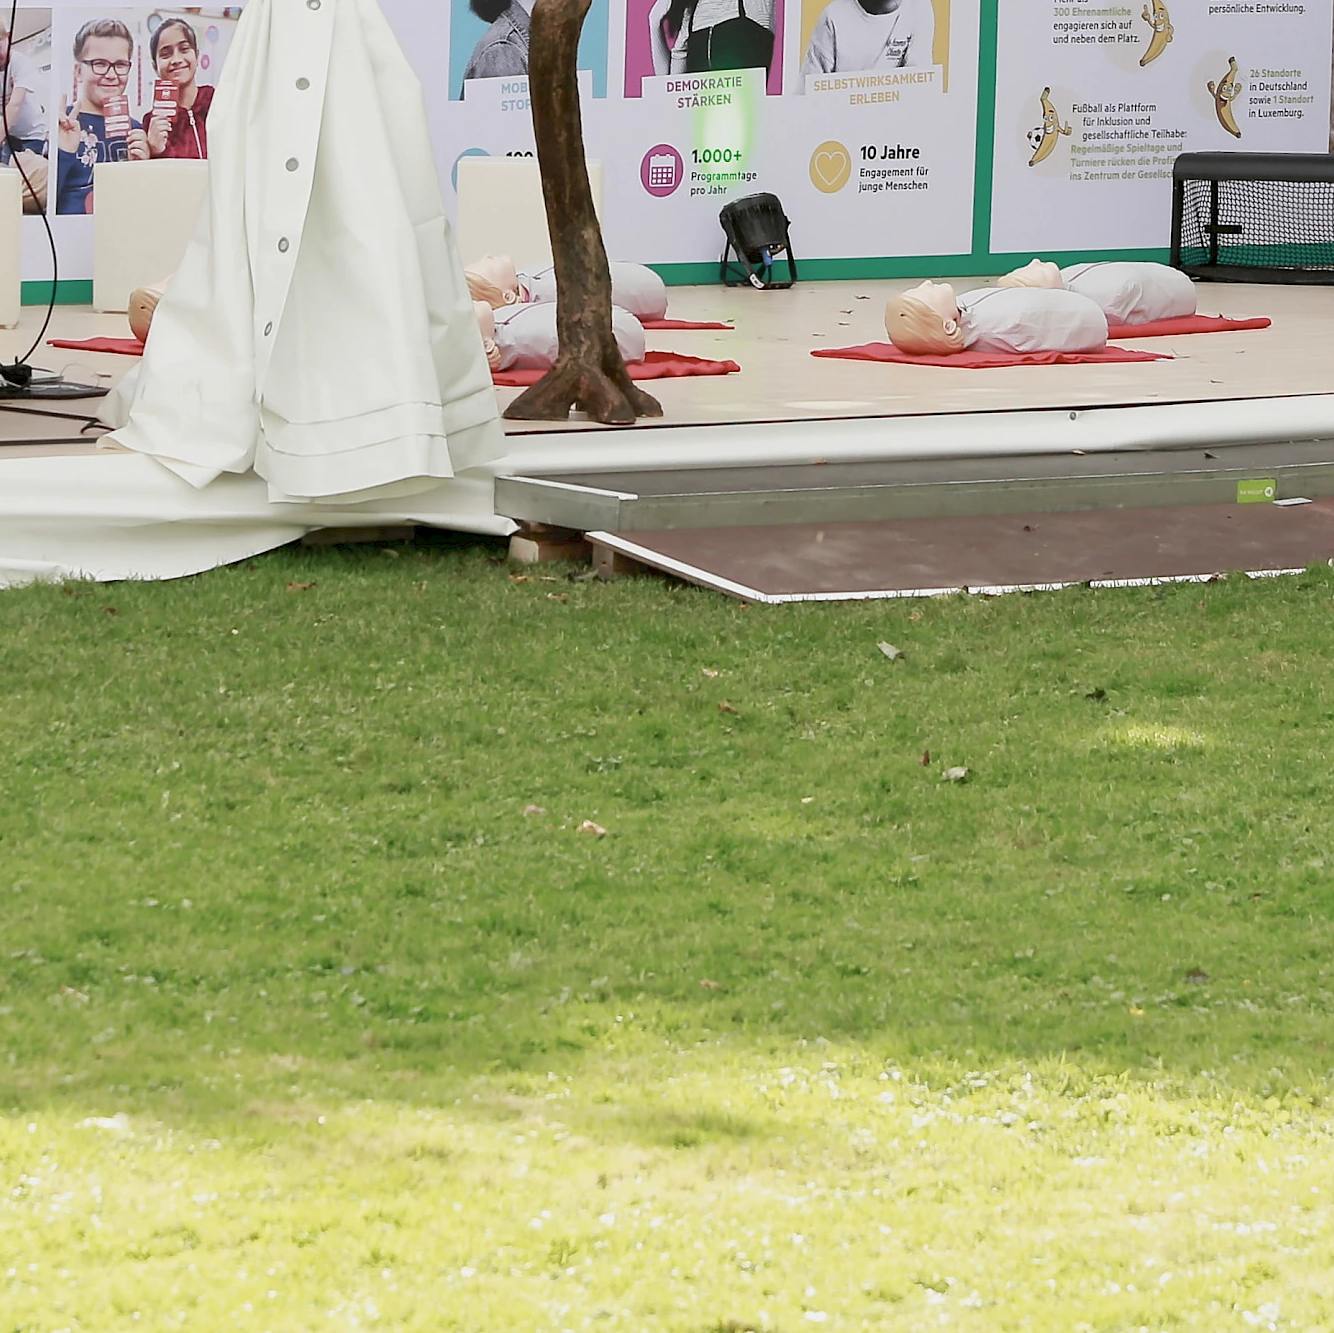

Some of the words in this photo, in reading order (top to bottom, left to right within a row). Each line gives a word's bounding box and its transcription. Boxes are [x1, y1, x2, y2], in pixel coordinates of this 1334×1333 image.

[1208, 4, 1254, 15] persönliche
[1256, 4, 1305, 14] Entwicklung.
[667, 77, 741, 92] DEMOKRATIE
[814, 71, 935, 92] SELBSTWIRKSAMKEIT
[677, 94, 731, 109] STÄRKEN
[849, 91, 900, 106] ERLEBEN
[692, 149, 741, 163] 1.000+
[861, 146, 876, 159] 10
[881, 145, 919, 159] Jahre
[691, 171, 757, 184] Programmtage
[860, 168, 913, 179] Engagement
[917, 167, 928, 175] für
[690, 186, 705, 197] pro
[708, 183, 727, 194] Jahr
[859, 182, 883, 193] junge
[886, 180, 927, 190] Menschen
